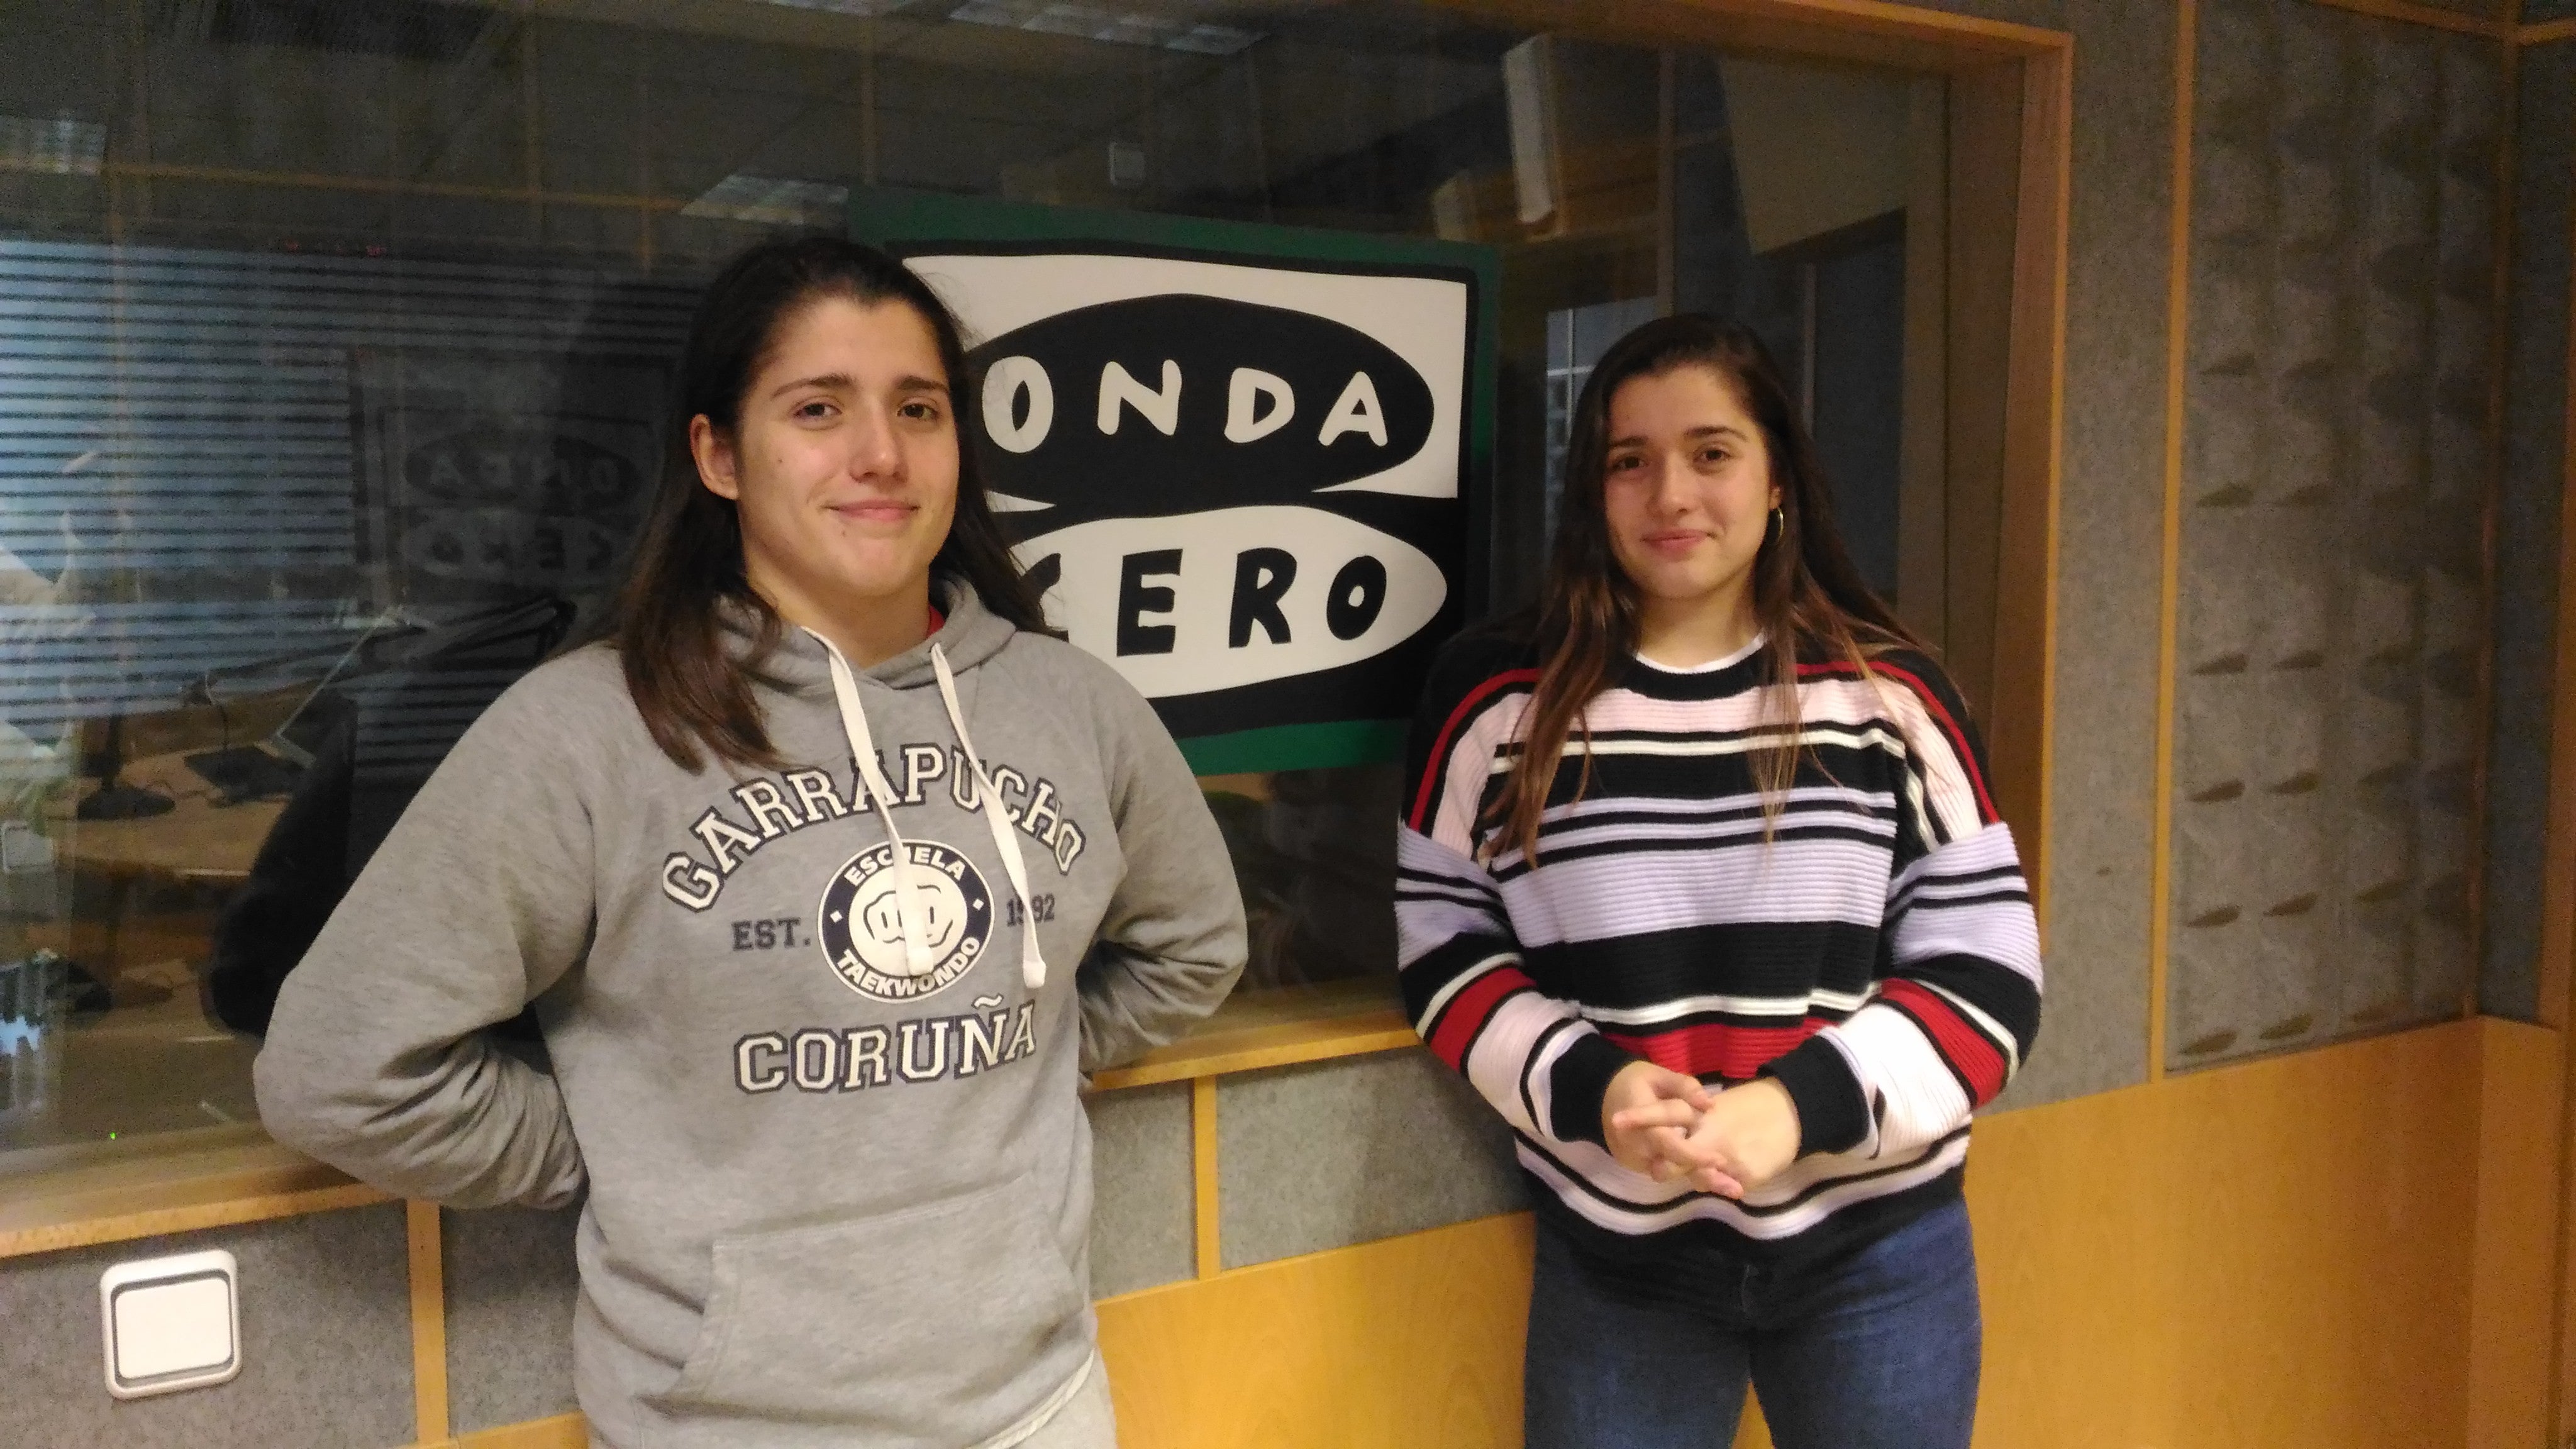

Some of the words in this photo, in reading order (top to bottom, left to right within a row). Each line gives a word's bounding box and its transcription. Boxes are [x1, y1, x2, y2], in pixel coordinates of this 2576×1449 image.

[982, 355, 1388, 453] ONDA
[662, 742, 1086, 913] GARRAPUCHO
[731, 918, 811, 951] EST.
[838, 936, 980, 997] TAEKWONDO
[733, 993, 1036, 1095] CORUÑA
